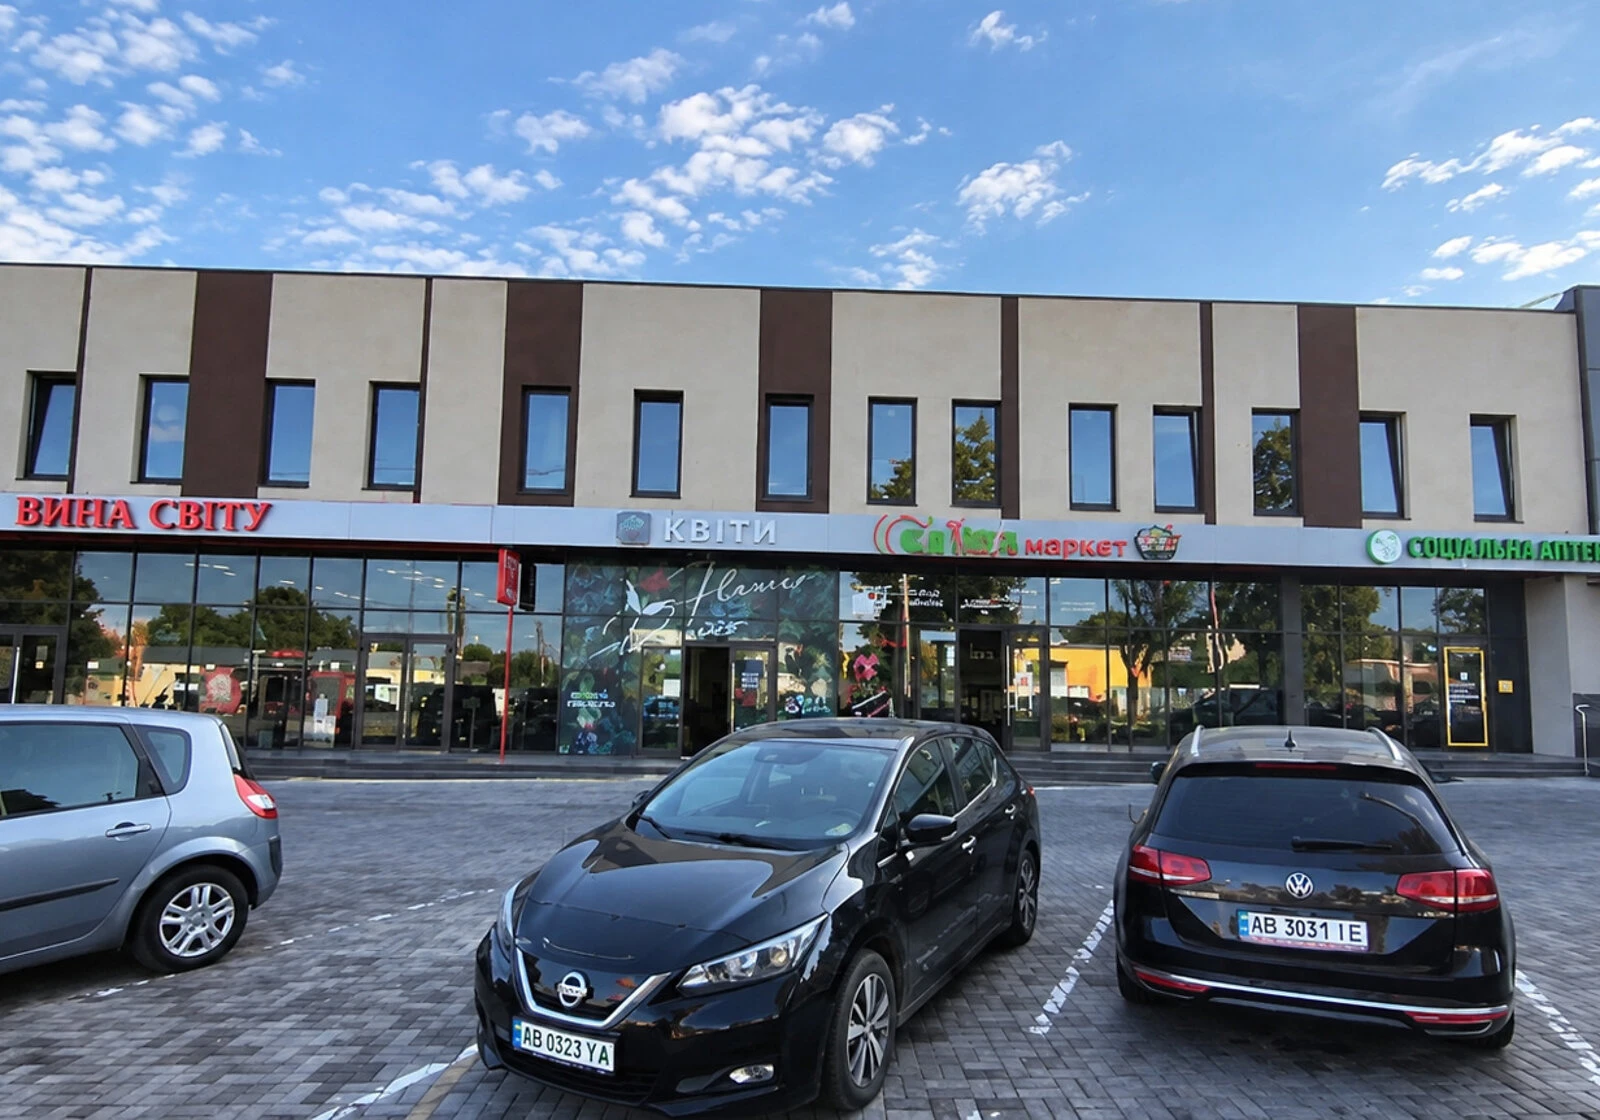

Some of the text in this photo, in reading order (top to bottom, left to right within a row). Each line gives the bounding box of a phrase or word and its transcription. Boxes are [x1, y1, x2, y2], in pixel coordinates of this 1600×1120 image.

[15, 496, 272, 533] ВИНА СВІТУ
[664, 518, 777, 546] КВІТИ
[1025, 538, 1128, 559] маркет
[1408, 536, 1535, 561] СОЦІАЛЬНА
[1251, 916, 1277, 935] AB
[1285, 918, 1329, 941] 3031
[1339, 923, 1362, 943] IE
[522, 1026, 542, 1049] AB
[546, 1033, 581, 1060] 0323
[586, 1042, 610, 1066] YA
